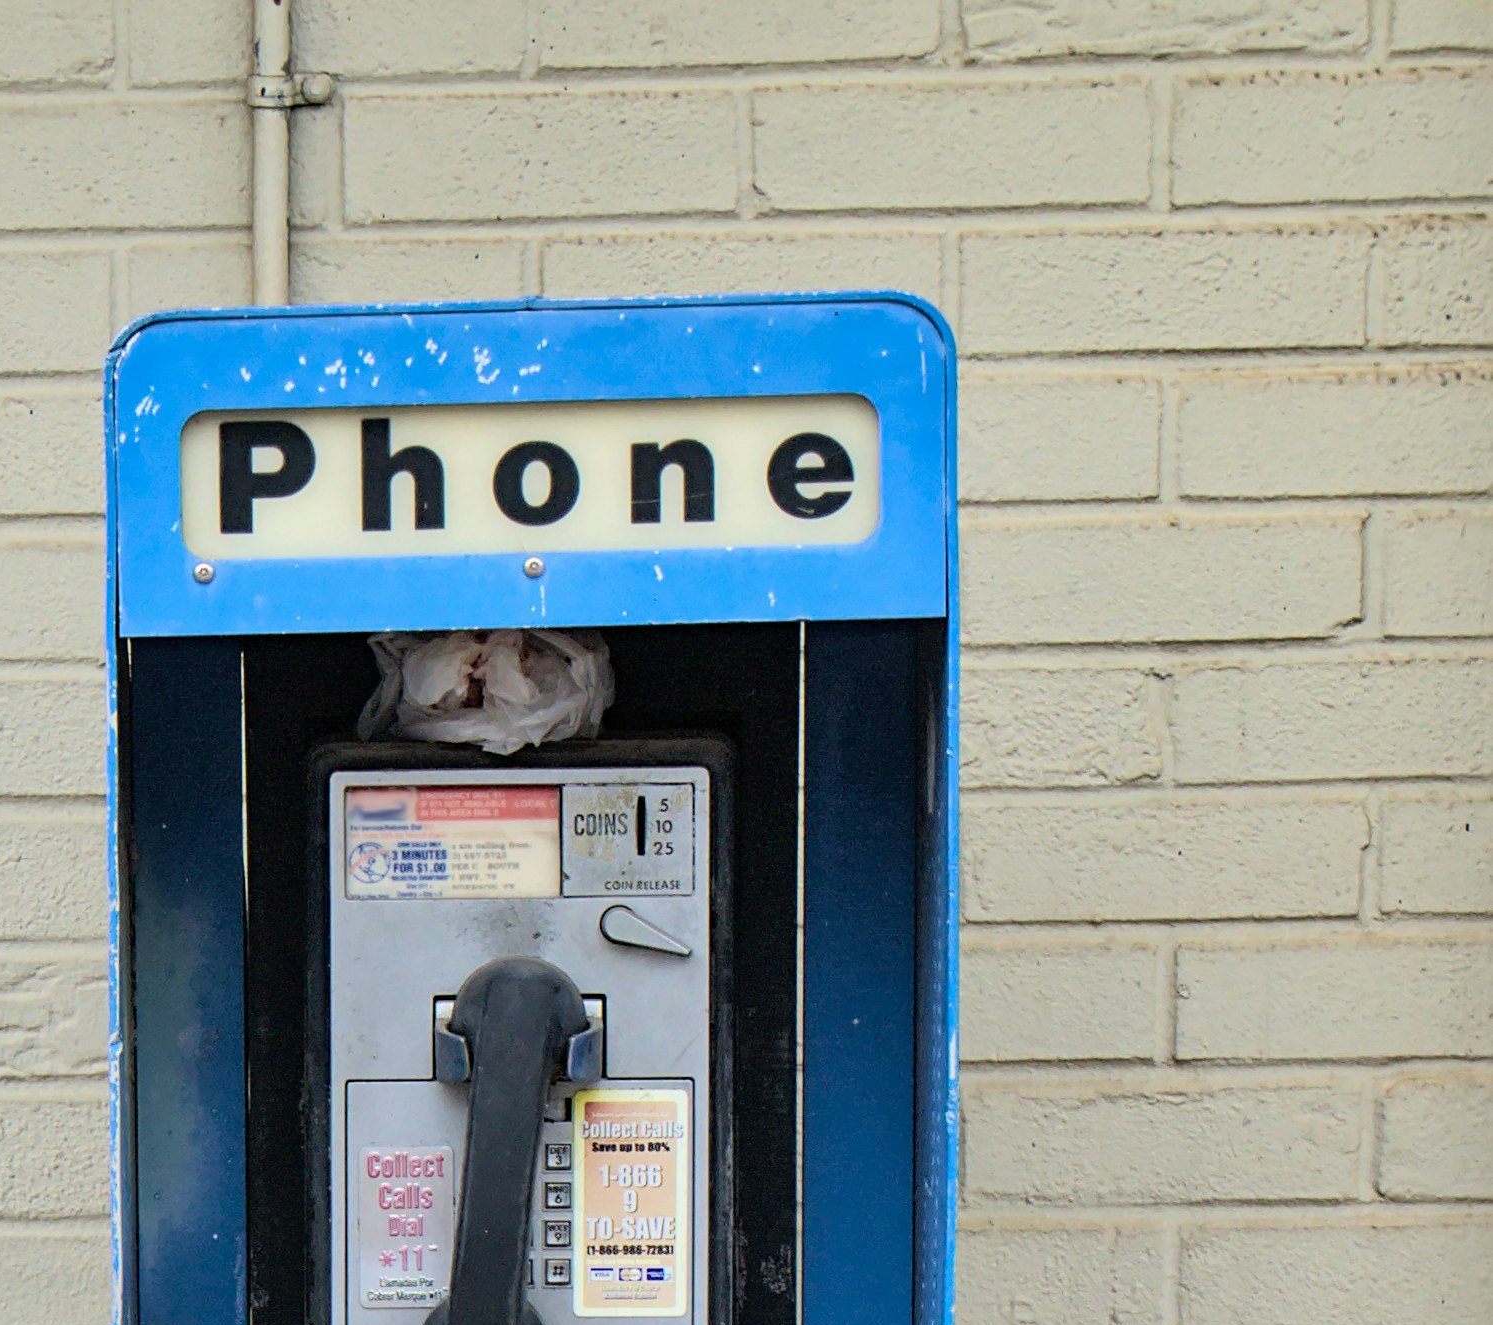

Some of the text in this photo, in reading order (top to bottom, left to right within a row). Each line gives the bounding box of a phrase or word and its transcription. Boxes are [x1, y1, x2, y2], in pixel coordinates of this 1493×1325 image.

[218, 418, 855, 534] Phone
[659, 799, 669, 812] 5
[574, 813, 628, 836] COINS
[656, 820, 673, 833] 10
[392, 850, 398, 861] 3
[402, 849, 447, 860] MINUTES
[654, 842, 674, 856] 25
[394, 863, 447, 873] FOR $1.00
[604, 880, 681, 890] COIN RELEASE
[580, 1120, 685, 1139] Collect Calls
[550, 1146, 568, 1155] DEF
[592, 1142, 671, 1152] Save up to 80%
[367, 1152, 445, 1178] Collect
[555, 1155, 562, 1165] 3
[599, 1163, 663, 1188] 1-866
[379, 1182, 433, 1209] Calls
[555, 1194, 563, 1204] 6
[623, 1188, 639, 1213] 9
[388, 1214, 424, 1237] Dial
[586, 1216, 676, 1240] TO-SAVE
[555, 1233, 563, 1242] 9
[419, 1278, 435, 1288] Por
